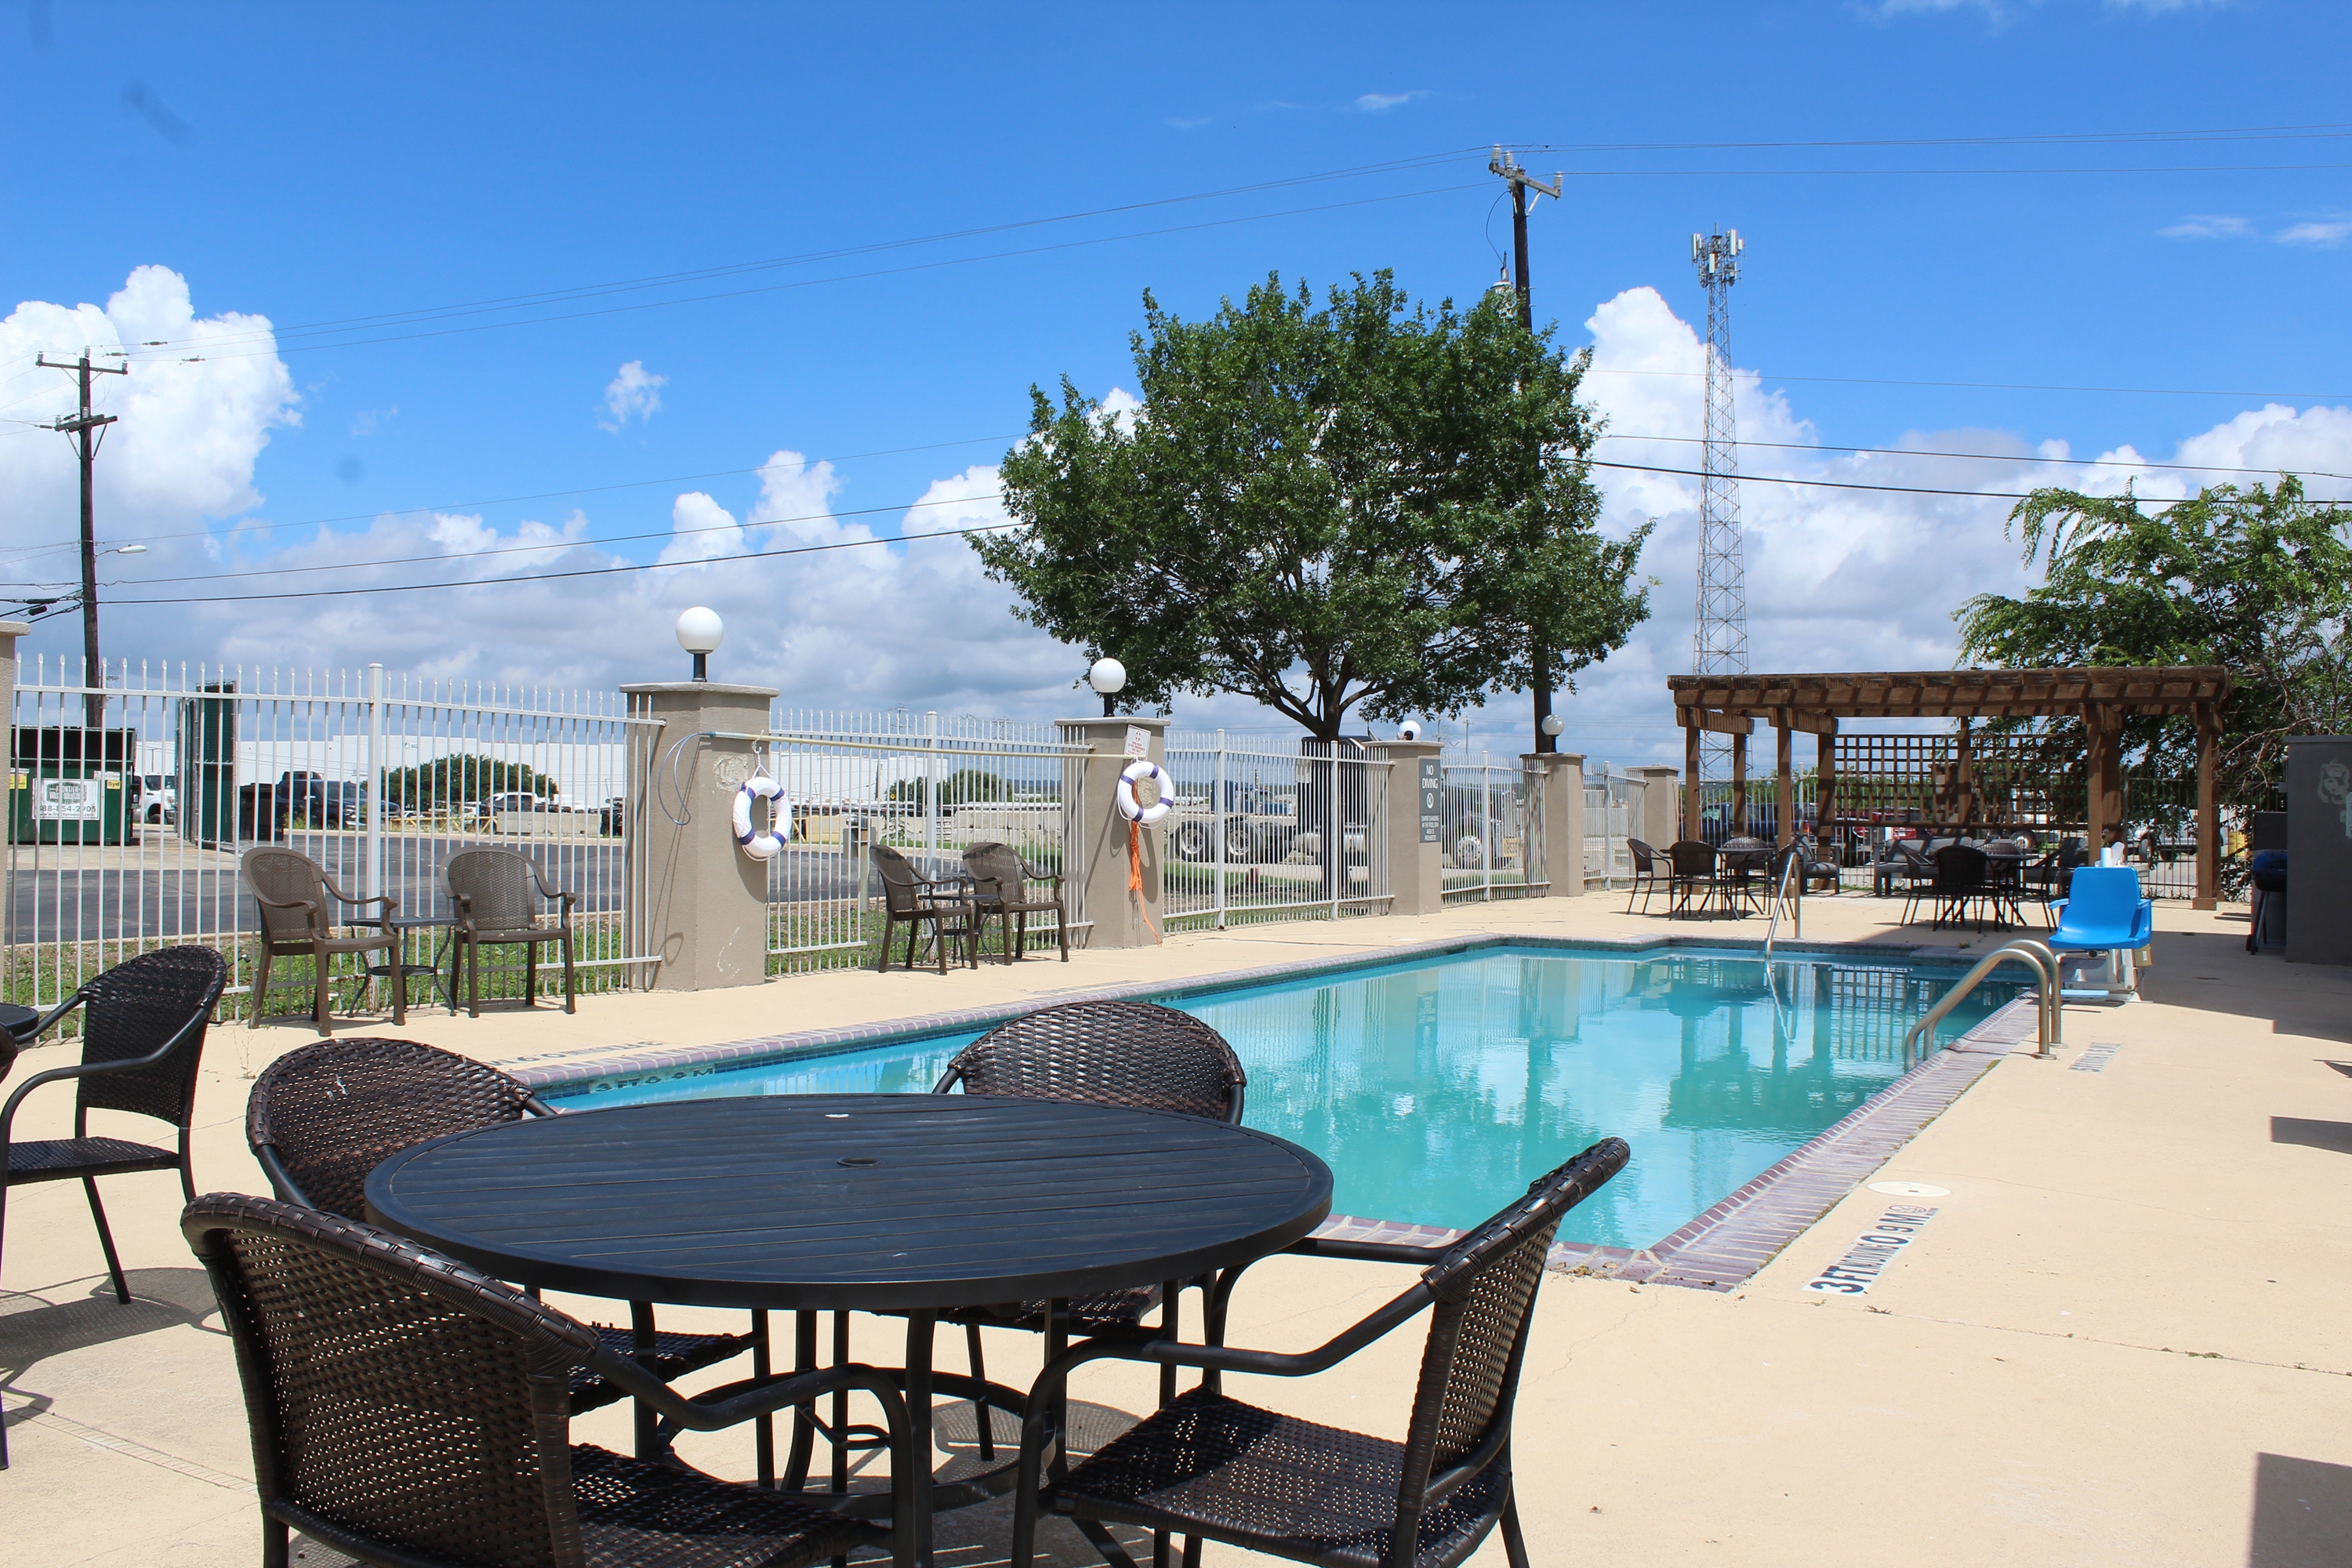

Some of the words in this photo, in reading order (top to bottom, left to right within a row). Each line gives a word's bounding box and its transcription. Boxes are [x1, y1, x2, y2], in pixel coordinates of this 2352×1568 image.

[1426, 764, 1434, 775] NO
[1421, 778, 1439, 789] DIVING
[693, 1068, 713, 1077] M
[1878, 1213, 1930, 1225] M
